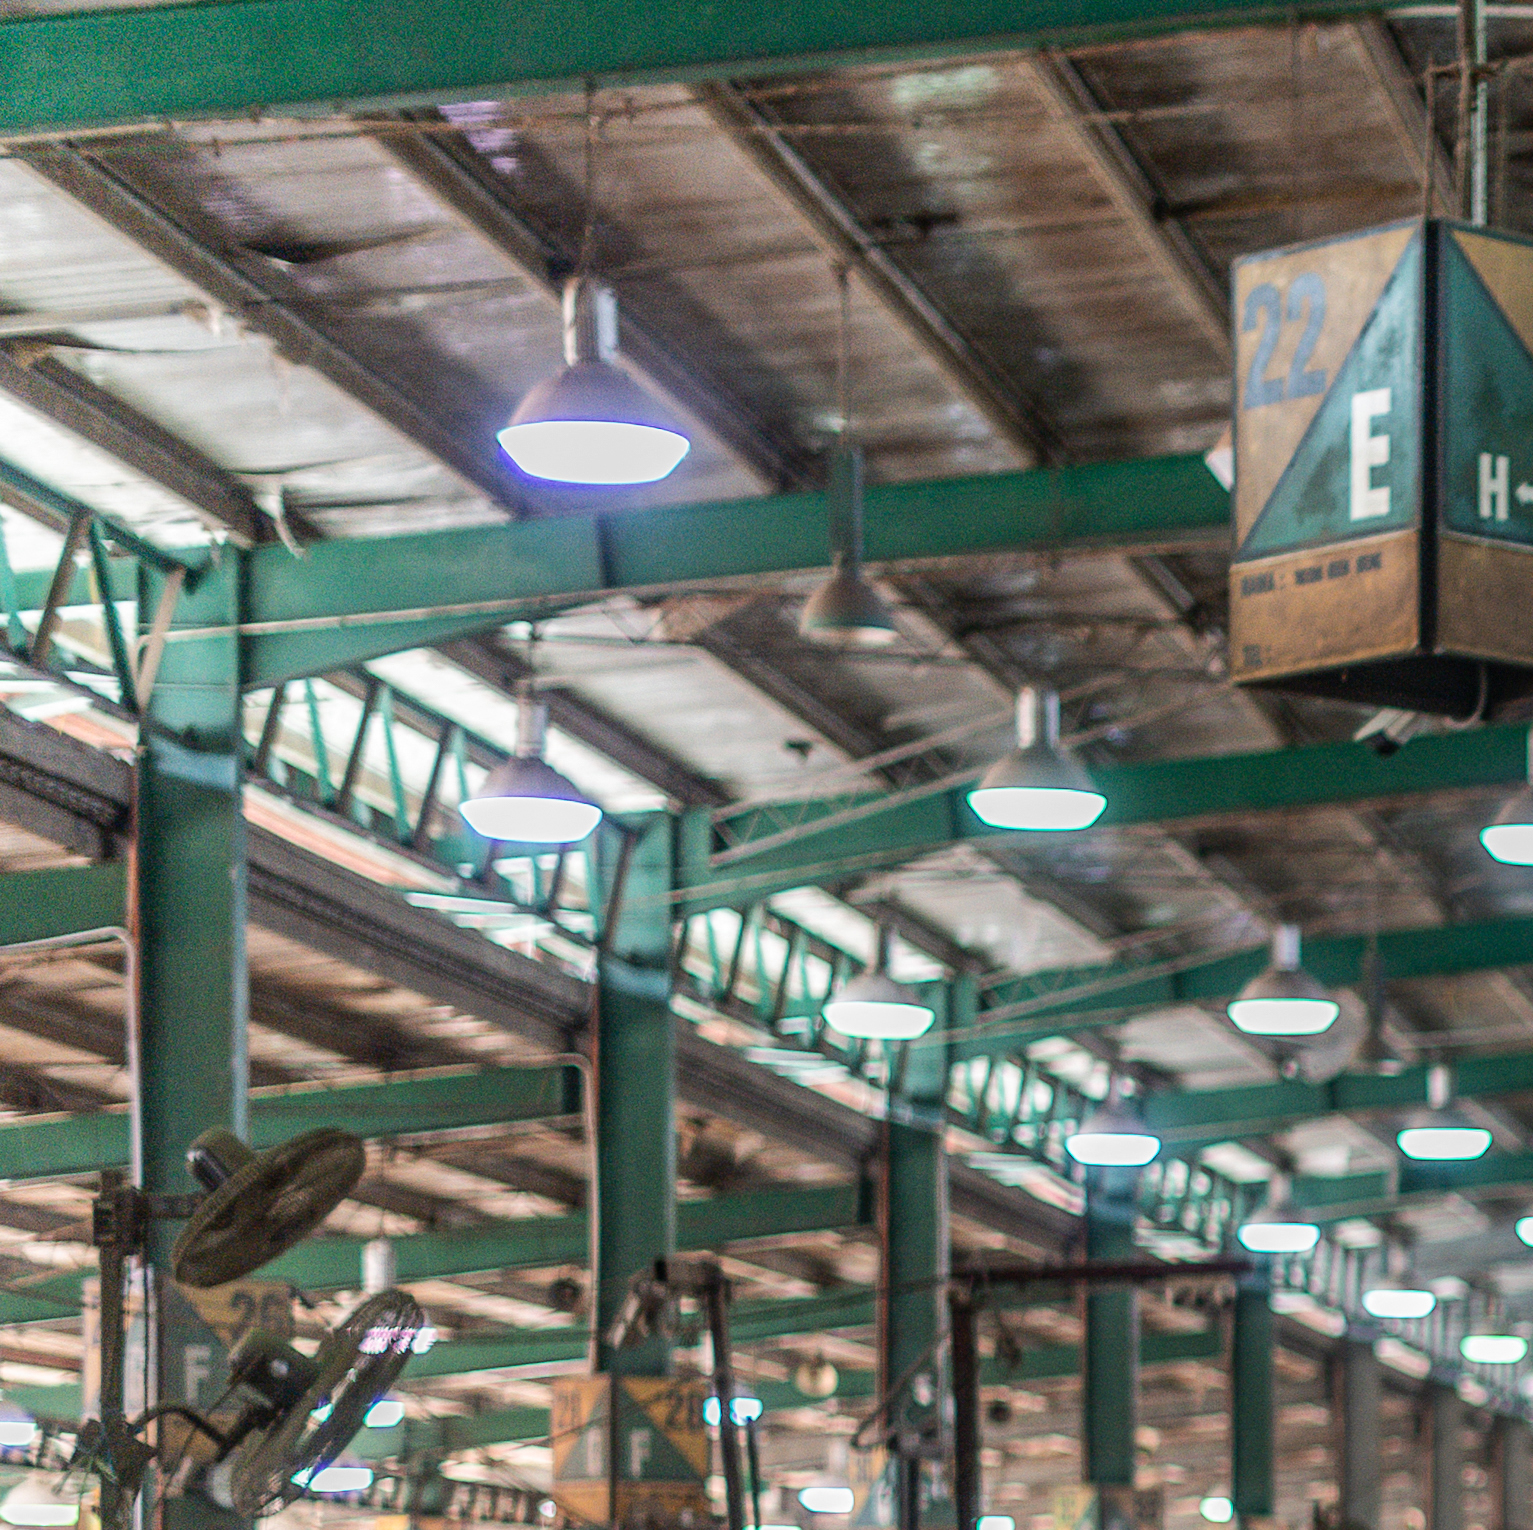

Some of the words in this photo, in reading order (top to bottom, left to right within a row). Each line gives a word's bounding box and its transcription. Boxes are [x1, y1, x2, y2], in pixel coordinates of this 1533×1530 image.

[1243, 273, 1326, 410] 22
[1350, 389, 1391, 523] E
[1480, 453, 1510, 522] H
[184, 1345, 213, 1406] F
[630, 1427, 652, 1478] F
